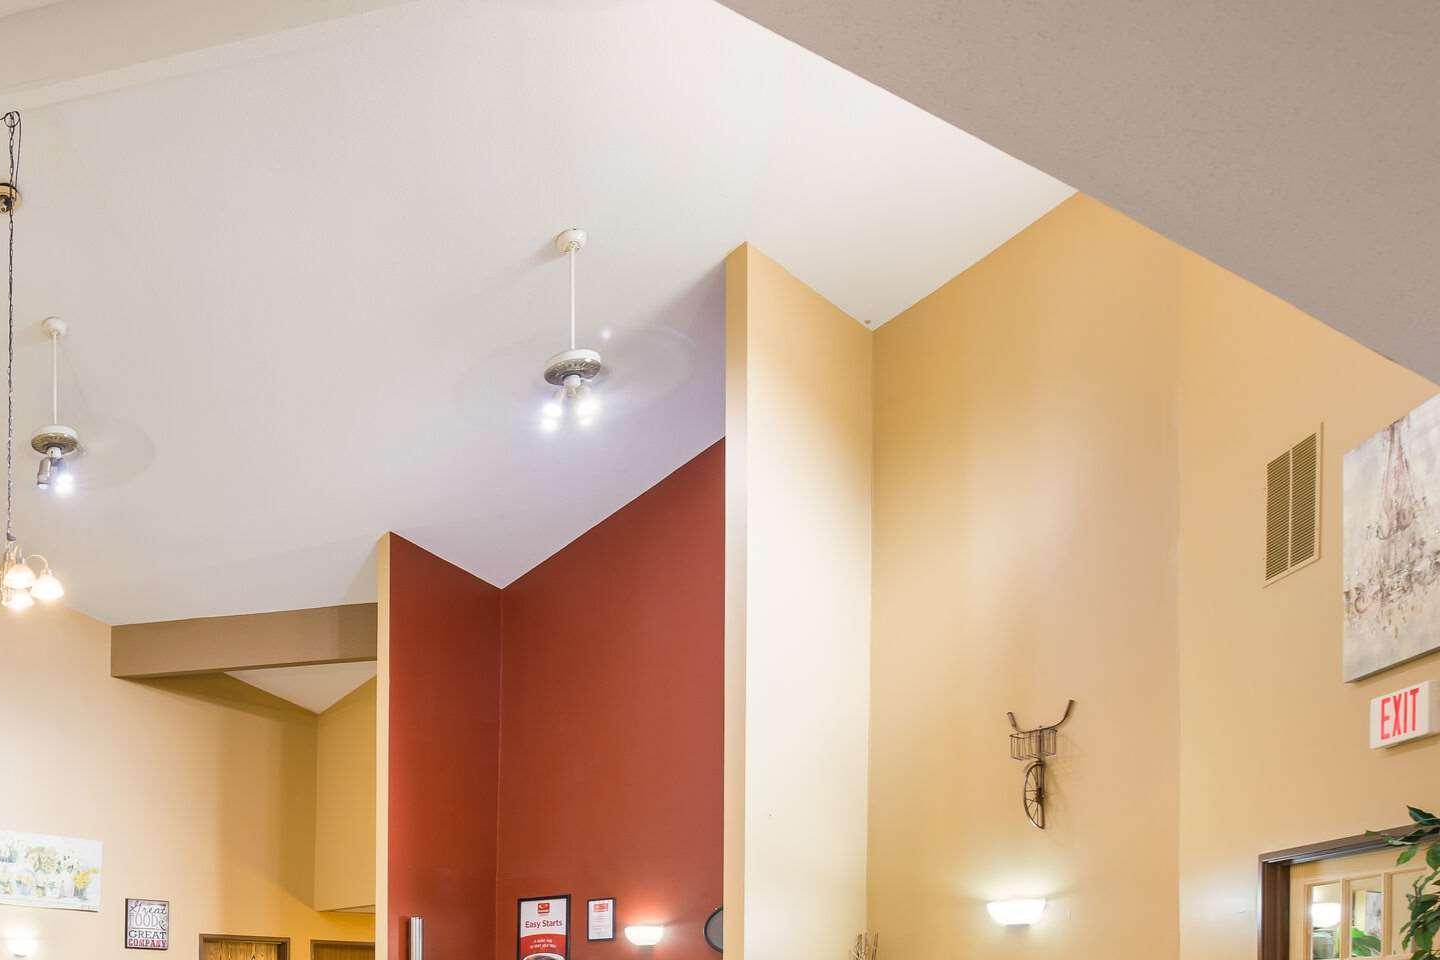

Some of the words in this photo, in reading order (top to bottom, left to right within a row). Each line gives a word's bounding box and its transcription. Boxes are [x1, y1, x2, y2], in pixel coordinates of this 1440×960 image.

[1380, 687, 1420, 740] EXIT
[525, 920, 541, 929] Easy
[542, 919, 563, 928] Starts
[128, 930, 167, 939] GREAT
[128, 938, 167, 948] COMPANY
